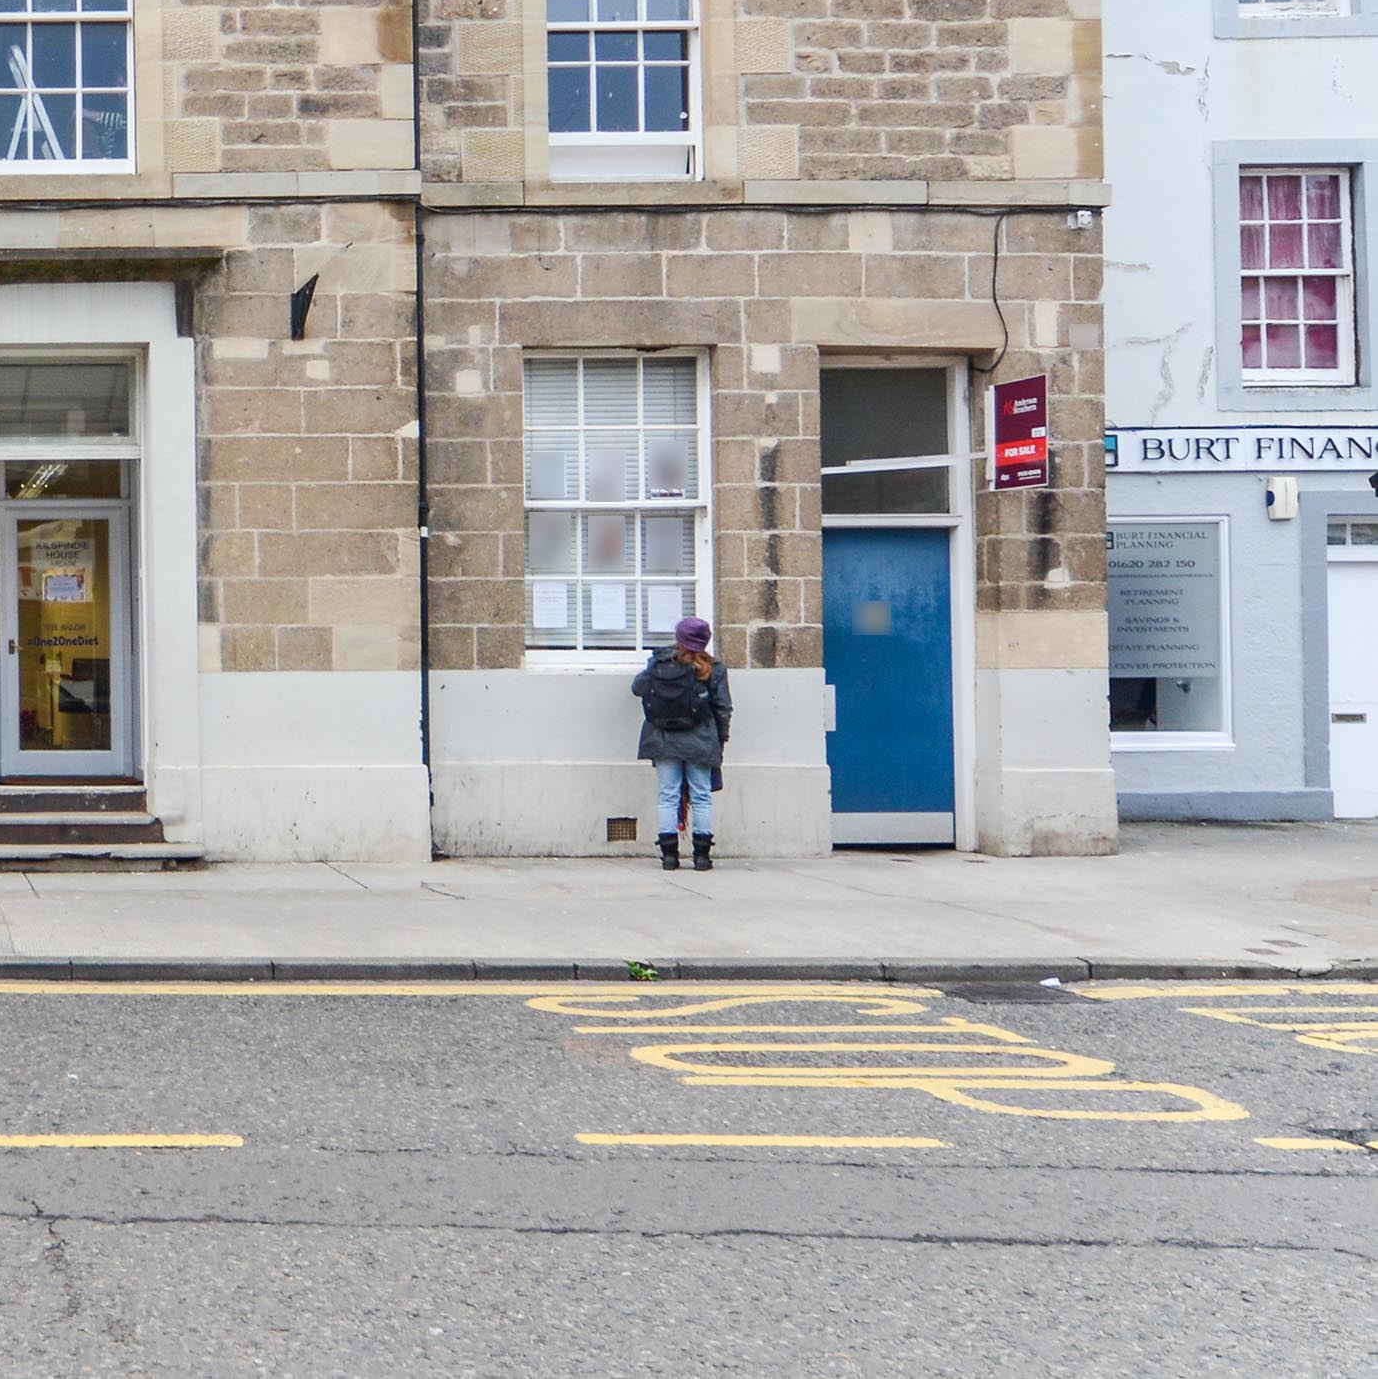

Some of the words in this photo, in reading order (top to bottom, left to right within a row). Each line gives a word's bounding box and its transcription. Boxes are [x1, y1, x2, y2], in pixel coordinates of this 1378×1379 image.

[1004, 447, 1019, 458] FOR
[1019, 444, 1036, 455] SALE
[1141, 437, 1239, 462] BURT
[1256, 436, 1378, 461] FINAN
[1116, 532, 1144, 540] BURT
[1148, 532, 1209, 540] FINANCIAL
[1116, 541, 1175, 549] PLANNING
[46, 551, 78, 560] HOUSE
[1108, 560, 1144, 569] 01620
[1148, 560, 1170, 568] 282
[1176, 560, 1196, 568] 150
[527, 996, 1250, 1122] STOP
